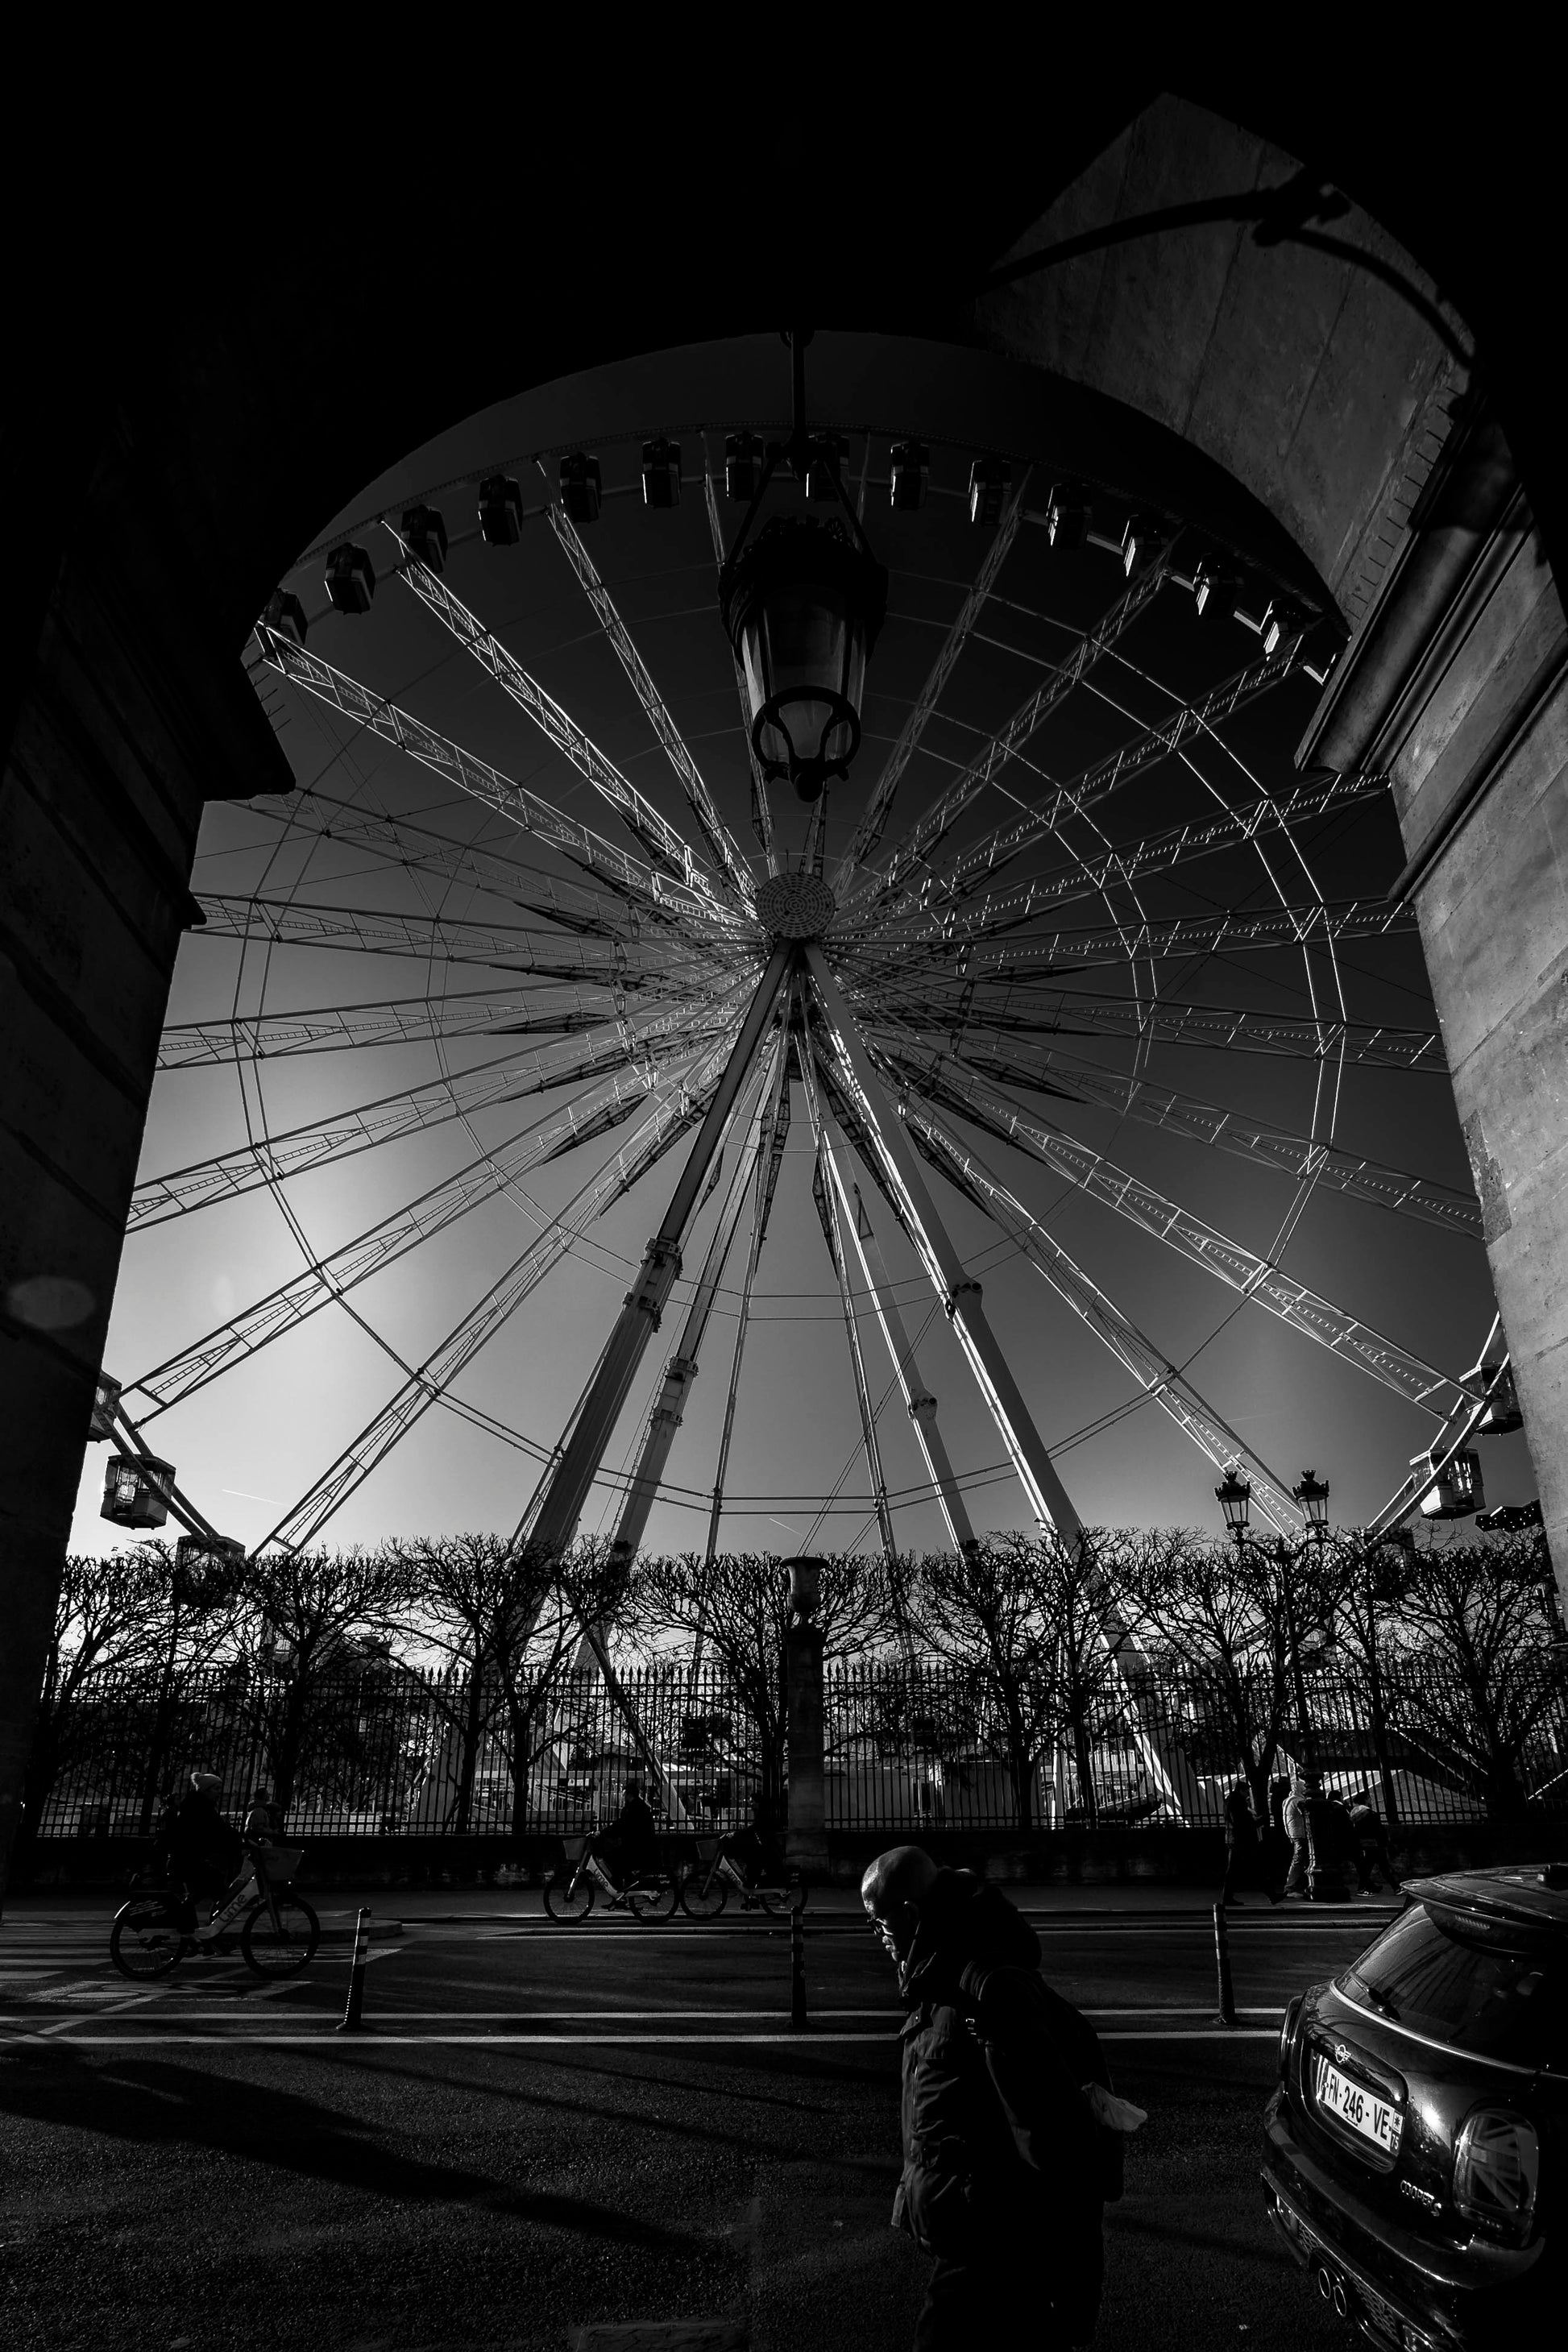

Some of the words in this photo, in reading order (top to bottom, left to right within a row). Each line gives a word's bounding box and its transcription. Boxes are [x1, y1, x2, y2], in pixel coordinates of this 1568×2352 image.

[218, 1894, 247, 1922] Lime
[1391, 2134, 1400, 2151] 75
[1400, 2180, 1435, 2207] COOPER
[1430, 2202, 1441, 2217] S
